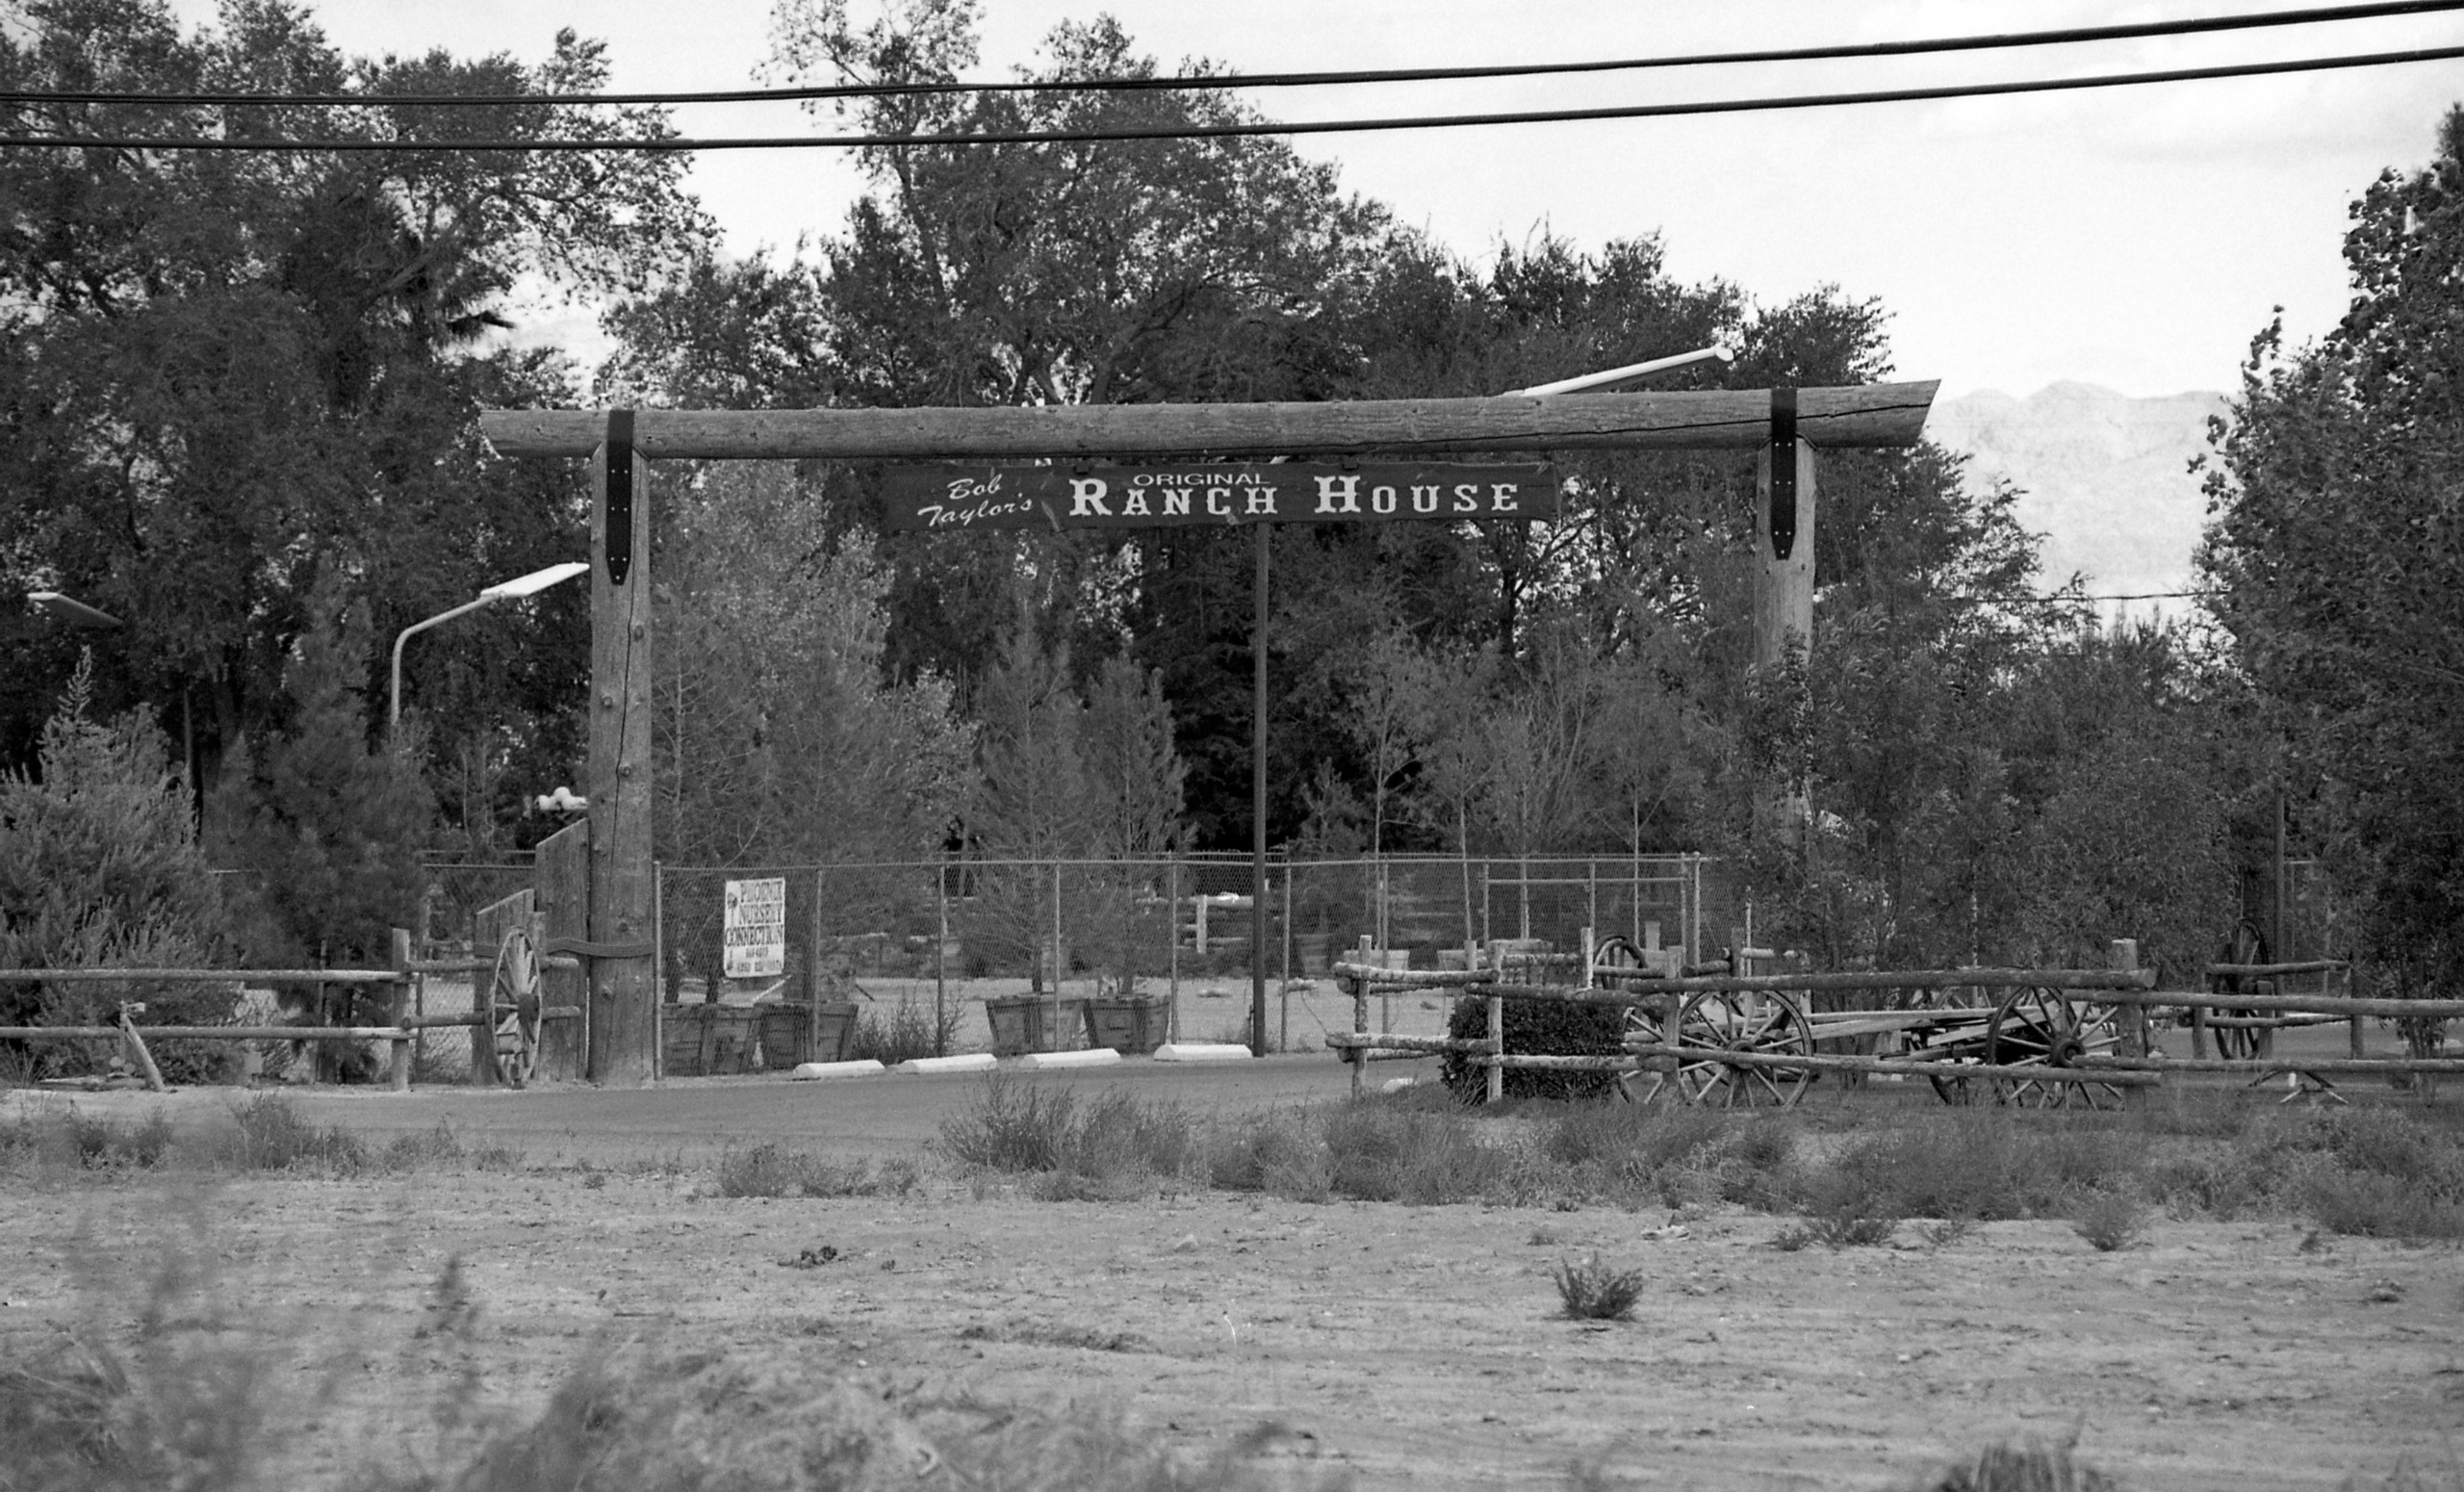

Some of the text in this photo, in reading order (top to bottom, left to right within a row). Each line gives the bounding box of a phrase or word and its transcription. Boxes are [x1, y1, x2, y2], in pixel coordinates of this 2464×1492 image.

[946, 474, 1002, 501] Bob
[1133, 473, 1270, 486] ORIGINAL
[1068, 475, 1519, 517] RANCH HOUSE
[916, 492, 1033, 527] Taylor's
[738, 903, 783, 925] NURSERY
[725, 925, 784, 947] CONNECTION
